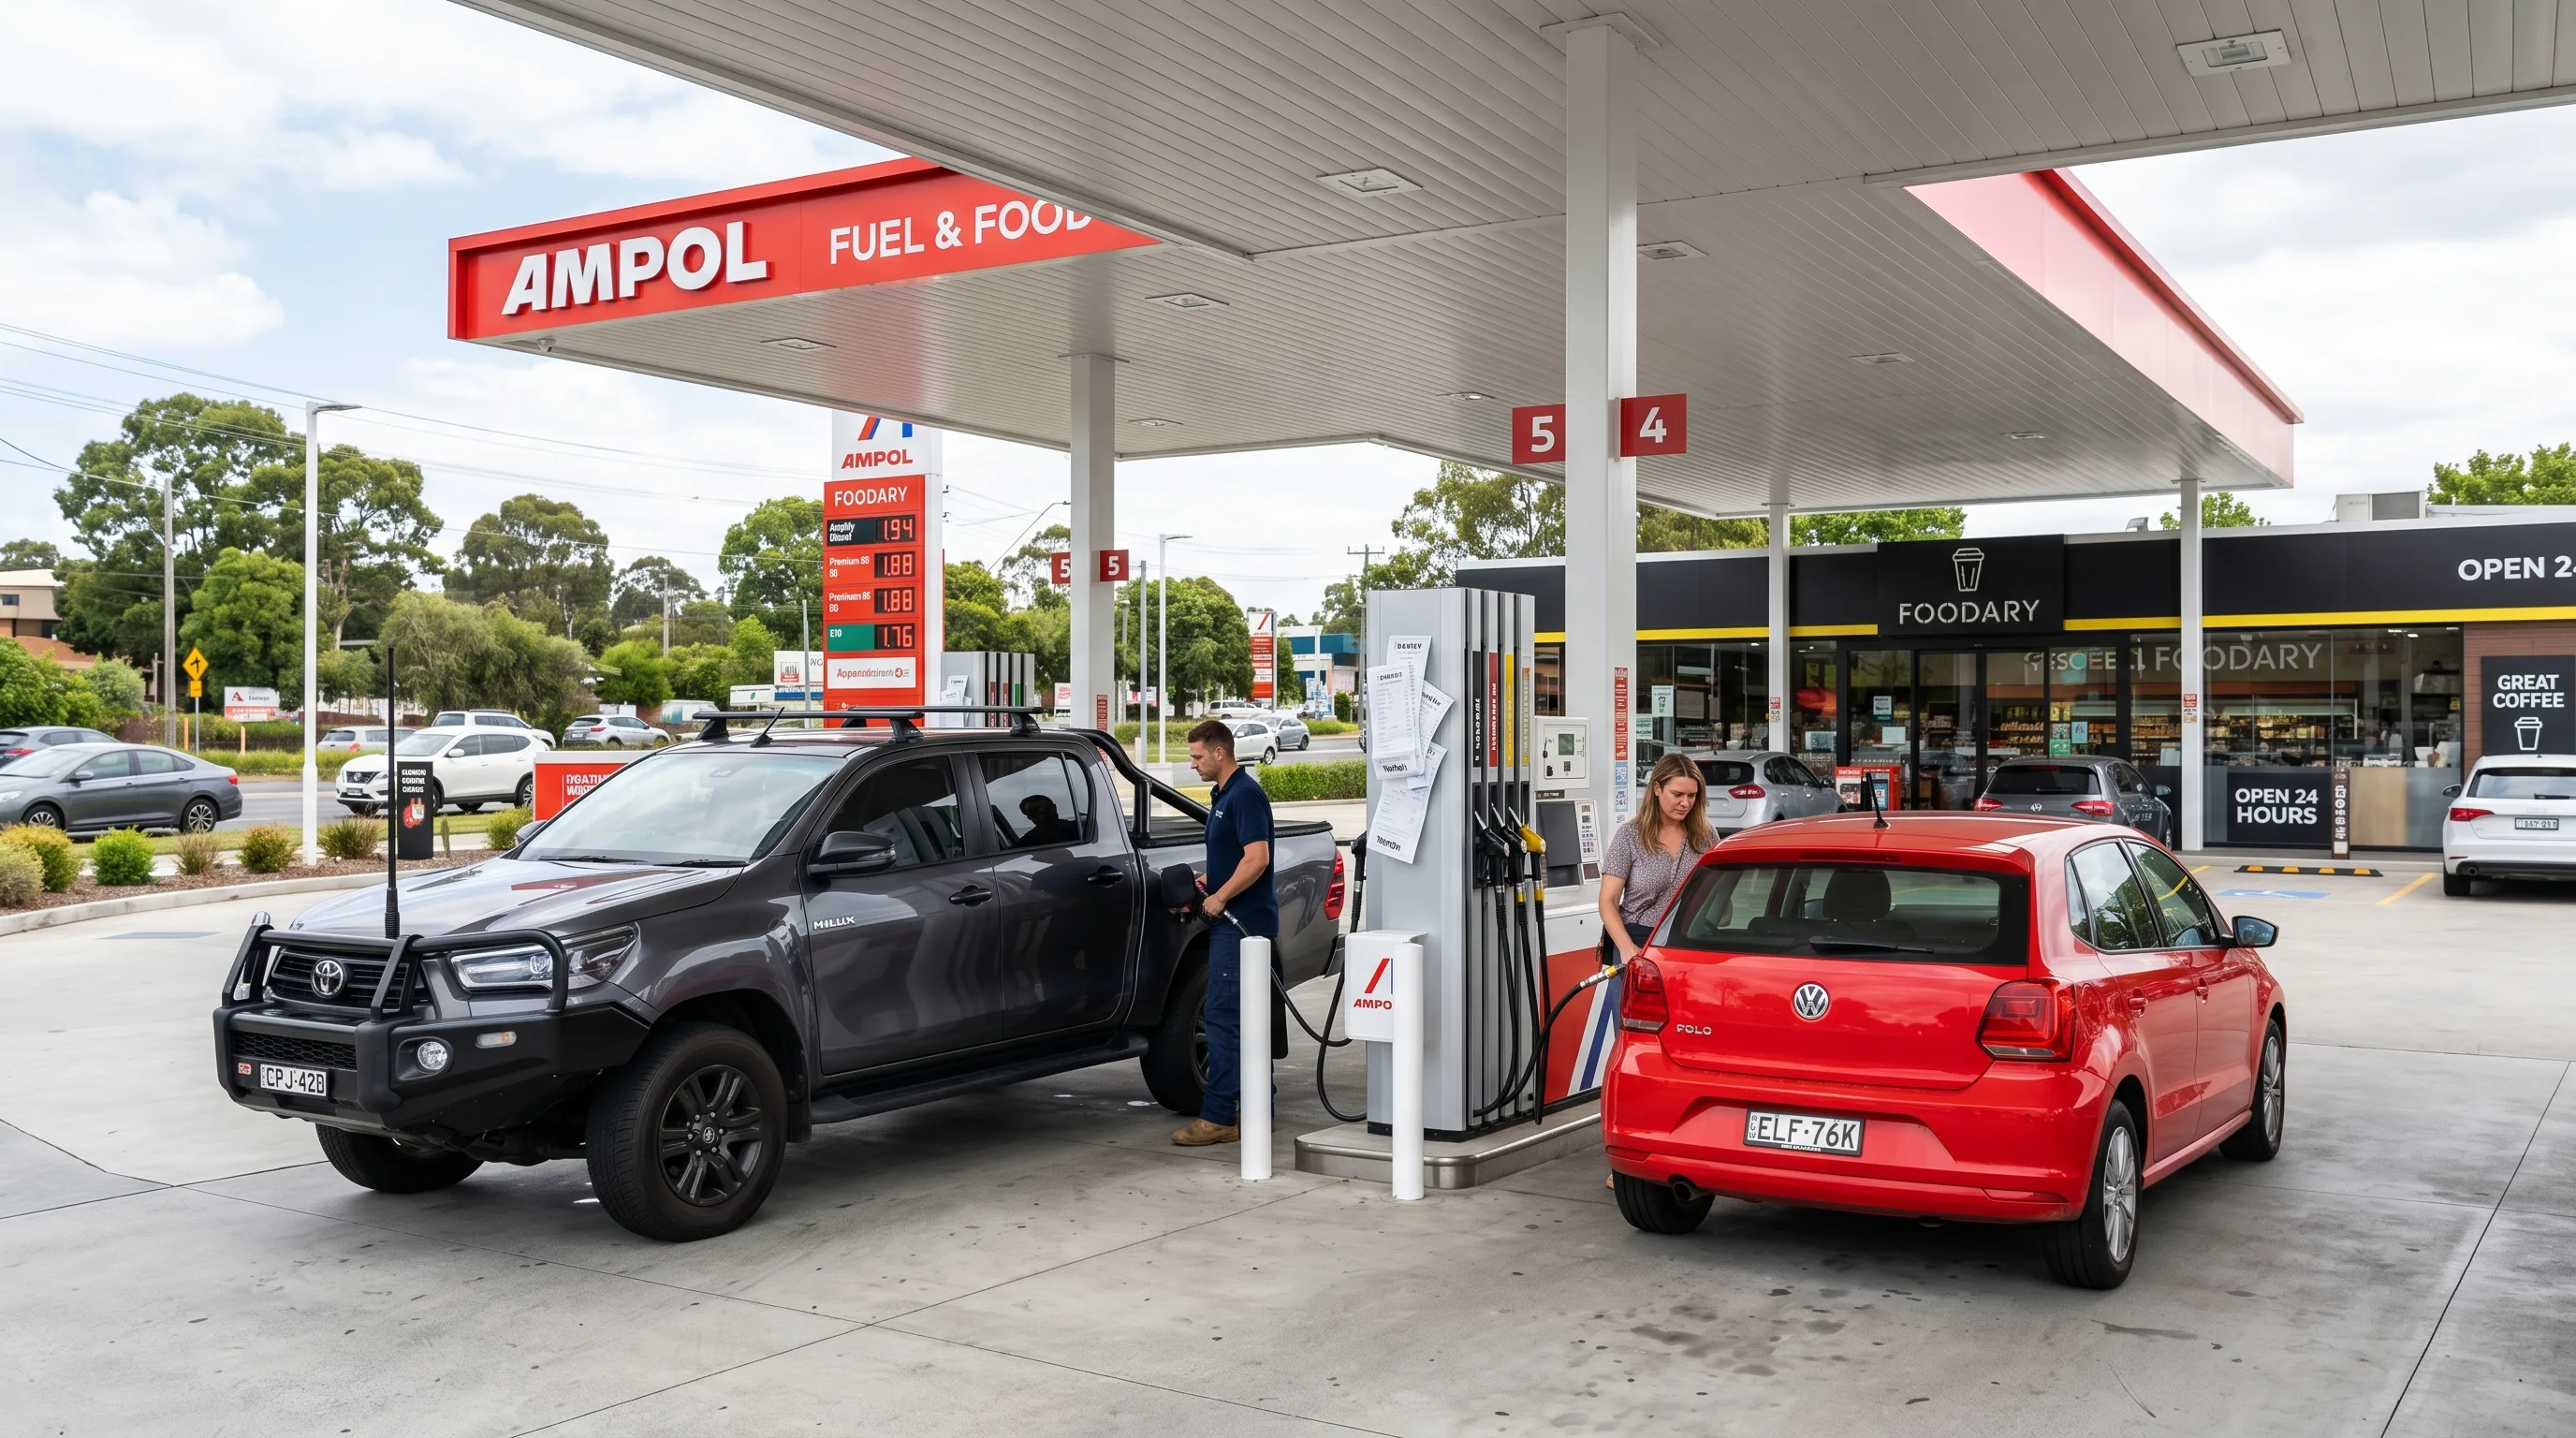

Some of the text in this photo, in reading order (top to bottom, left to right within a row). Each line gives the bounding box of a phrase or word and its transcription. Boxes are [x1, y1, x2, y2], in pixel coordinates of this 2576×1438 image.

[830, 216, 925, 265] FUEL
[935, 210, 963, 250] &
[501, 220, 768, 315] AMPOL
[1530, 415, 1556, 453] 5
[1639, 406, 1667, 444] 4
[841, 449, 914, 469] AMPOL
[834, 486, 908, 506] FOODARY
[884, 519, 913, 540] 1.94
[884, 554, 913, 577] 1.88
[1107, 555, 1120, 576] 5
[2457, 556, 2545, 581] OPEN
[884, 589, 913, 612] 1.88
[1898, 599, 2041, 625] FOODARY
[829, 629, 842, 638] E10
[884, 625, 913, 648] 1.76
[2497, 674, 2559, 690] GREAT
[2493, 693, 2565, 708] COFFEE
[2235, 788, 2319, 804] OPEN 24
[2236, 806, 2318, 825] HOURS
[1353, 998, 1393, 1010] AMPO
